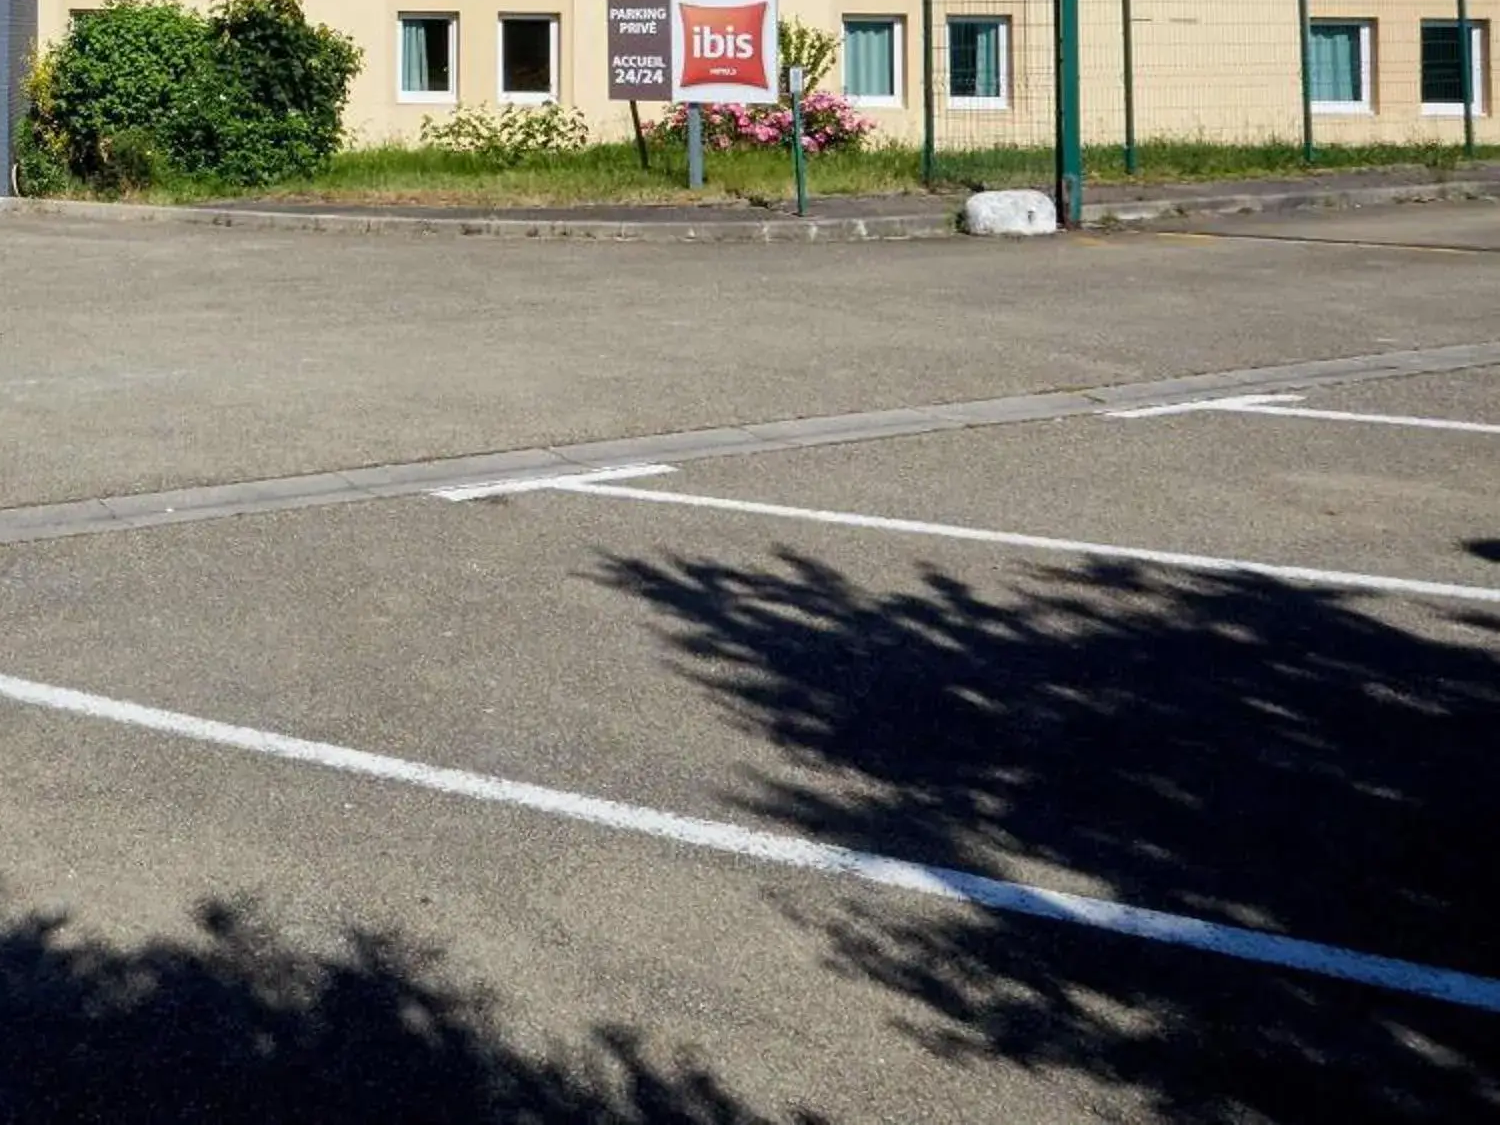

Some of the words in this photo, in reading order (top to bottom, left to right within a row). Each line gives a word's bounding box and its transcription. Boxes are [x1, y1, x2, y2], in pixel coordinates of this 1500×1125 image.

[609, 8, 667, 20] PARKING
[692, 26, 754, 59] ibis
[612, 56, 667, 68] ACCUEIL
[615, 69, 663, 84] 24/24
